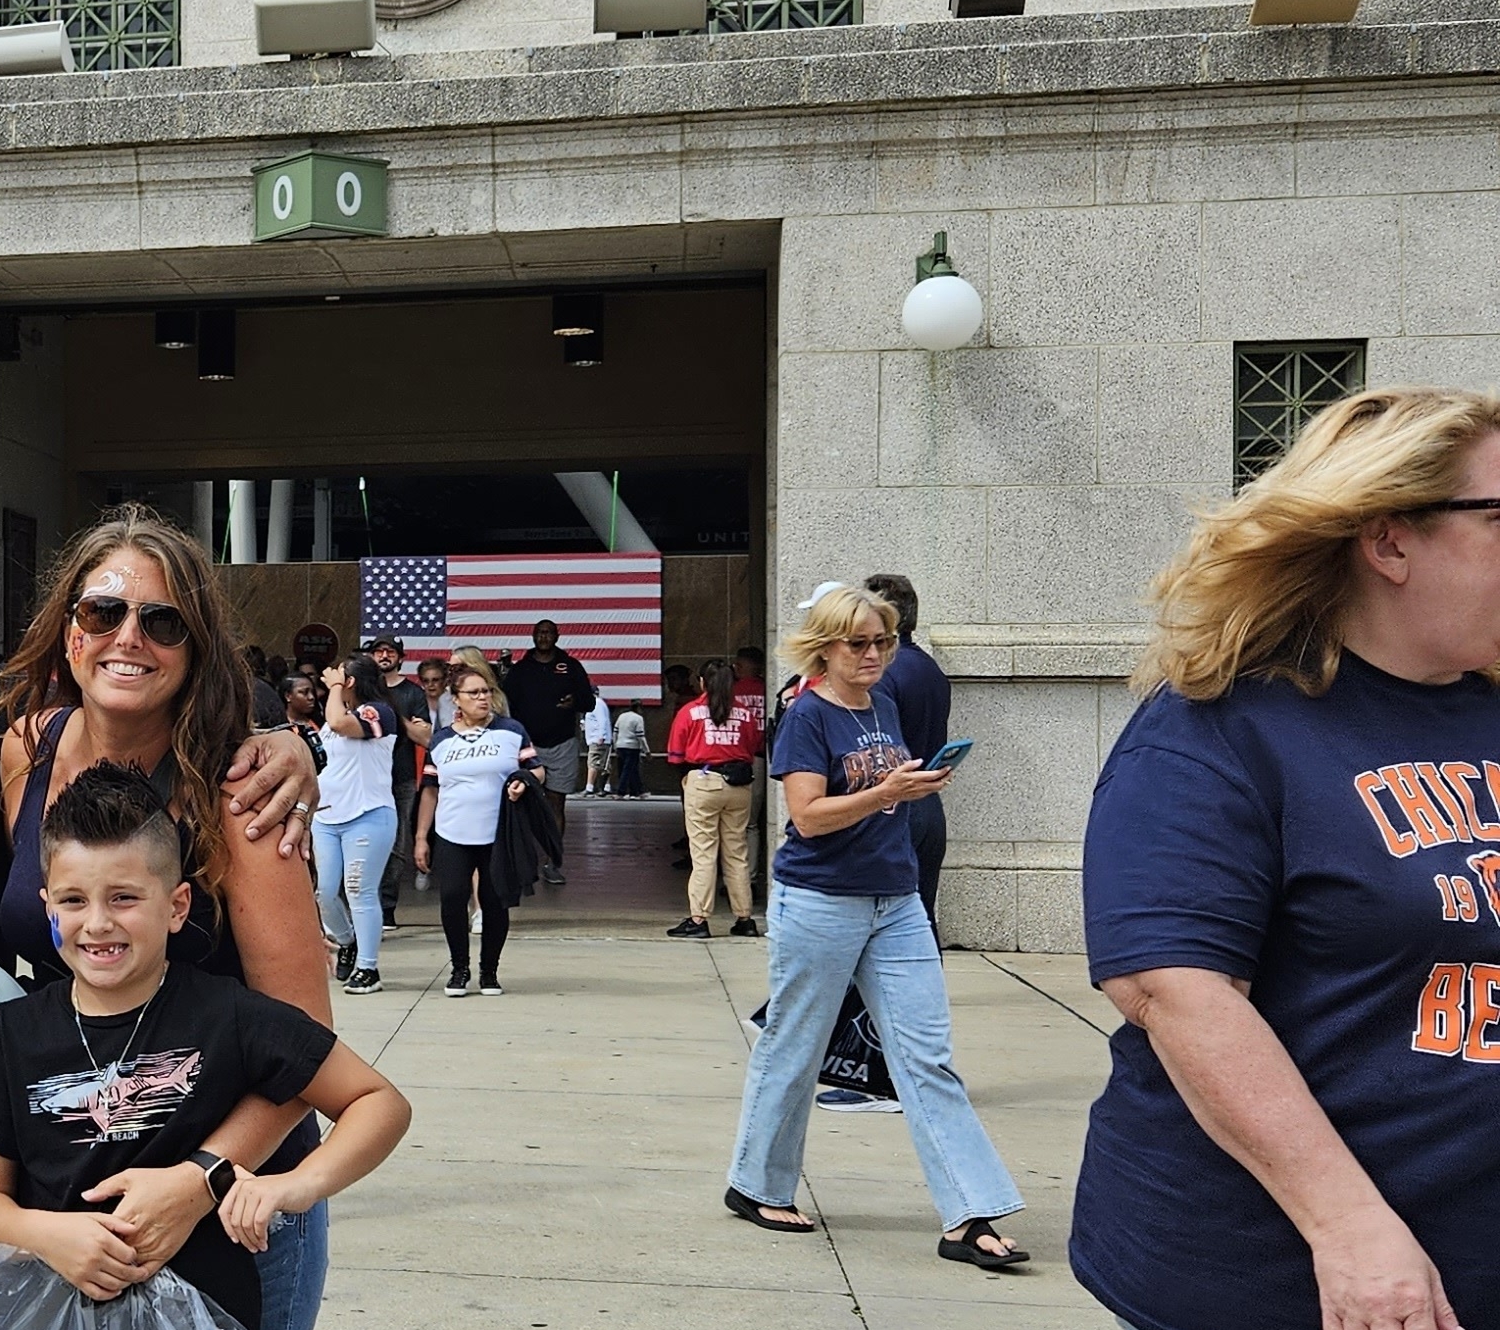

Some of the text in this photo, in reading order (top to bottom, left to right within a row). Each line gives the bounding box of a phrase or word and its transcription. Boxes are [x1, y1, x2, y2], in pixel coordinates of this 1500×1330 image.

[704, 731, 741, 746] STAFF
[443, 744, 501, 766] BEARS
[111, 1130, 140, 1142] BEACH
